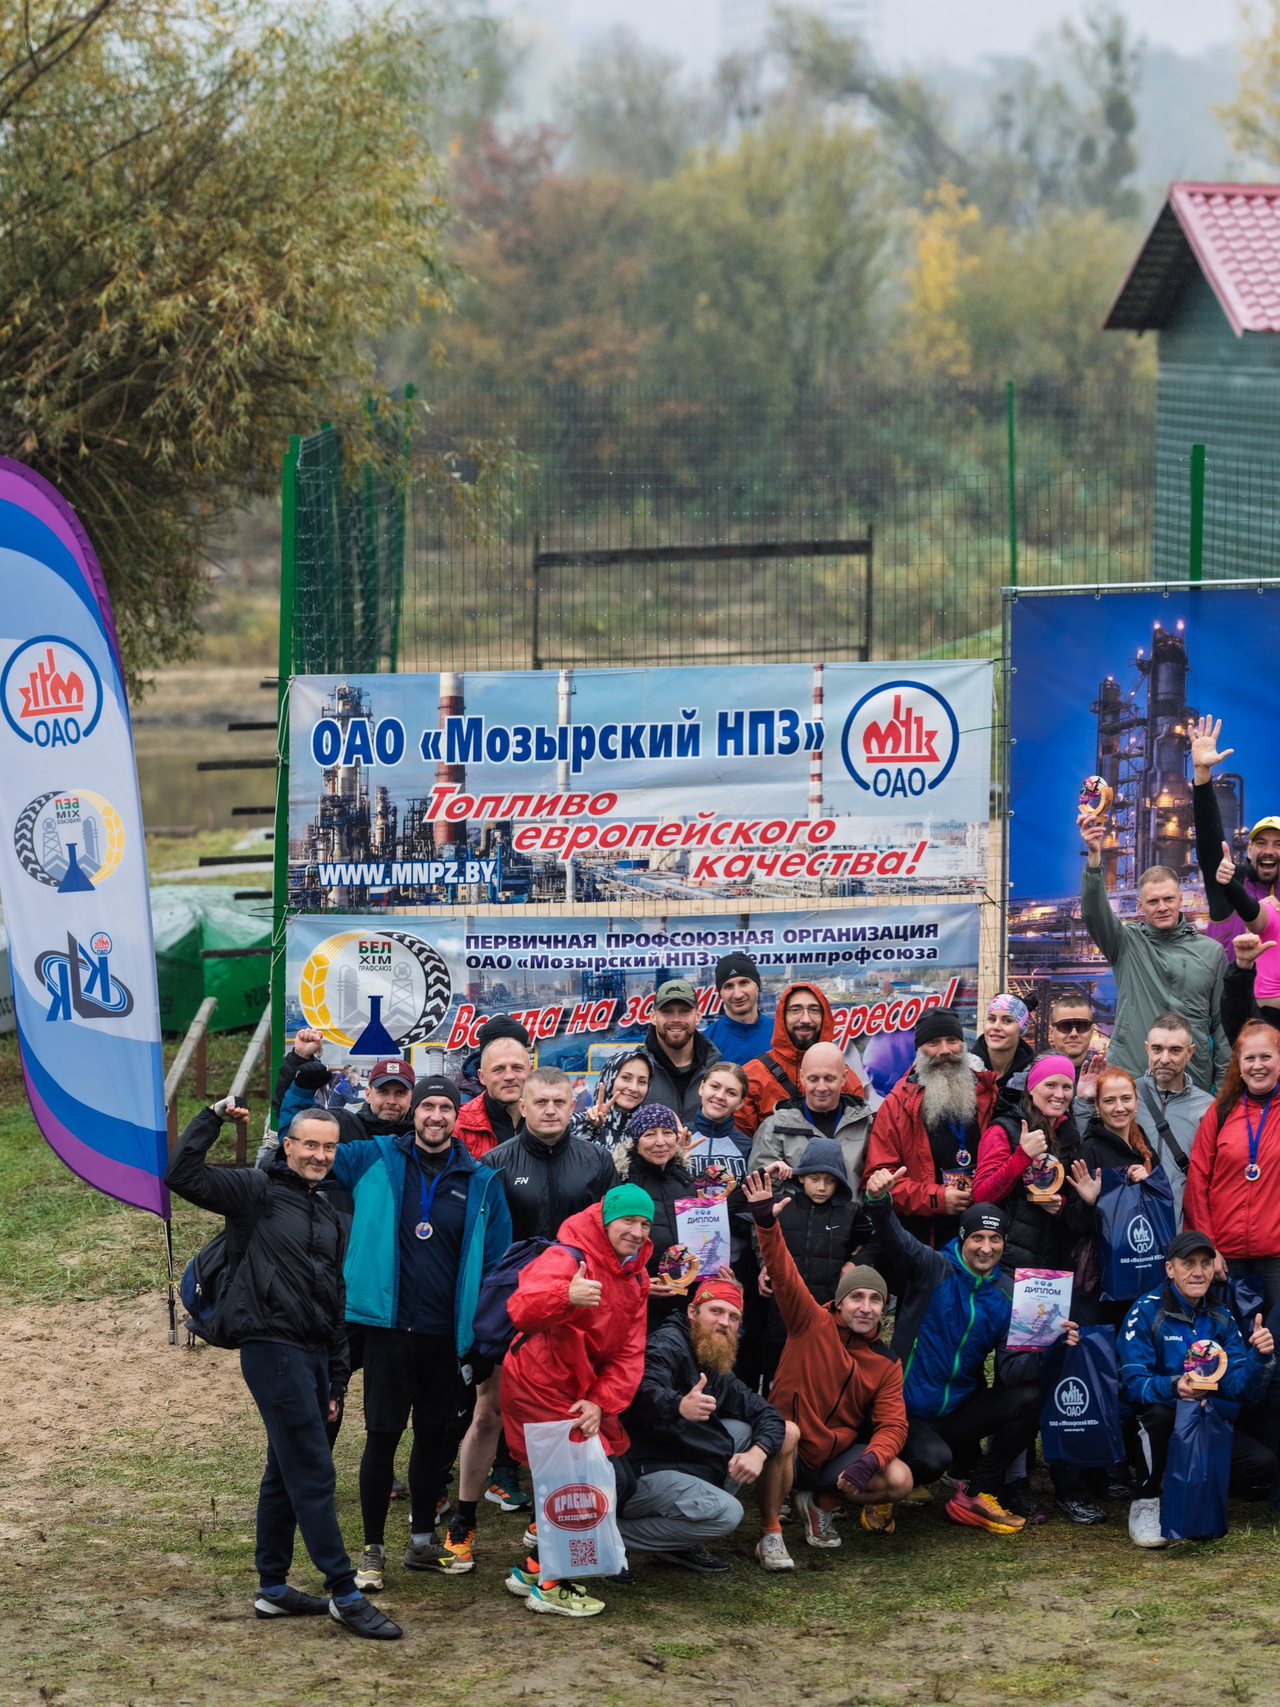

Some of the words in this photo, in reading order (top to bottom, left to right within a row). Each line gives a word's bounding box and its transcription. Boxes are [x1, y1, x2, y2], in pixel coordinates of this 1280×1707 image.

[312, 717, 405, 766] ОАО
[419, 708, 701, 774] «Мозырский
[716, 708, 825, 757] НПЗ»
[873, 767, 926, 798] ОАО
[426, 786, 618, 820] Топливо
[514, 812, 836, 860] европейского
[318, 860, 497, 886] WWW.MNPZ.BY
[693, 841, 928, 878] качества!
[359, 941, 392, 954] БЕЛ
[465, 933, 597, 950] ПЕРВИЧНАЯ
[606, 930, 774, 949] ПРОФСОЮЗНАЯ
[782, 923, 939, 945] ОРГАНИЗАЦИЯ
[466, 954, 512, 970] ОАО
[517, 952, 660, 972] «Мозырский
[665, 951, 721, 967] НПЗ»
[731, 946, 938, 967] елхимпрофсоюза
[567, 999, 617, 1034] на
[687, 1216, 720, 1225] ДИПЛОМ
[1024, 1286, 1061, 1296] ДИПЛОМ
[1037, 1304, 1045, 1316] 3
